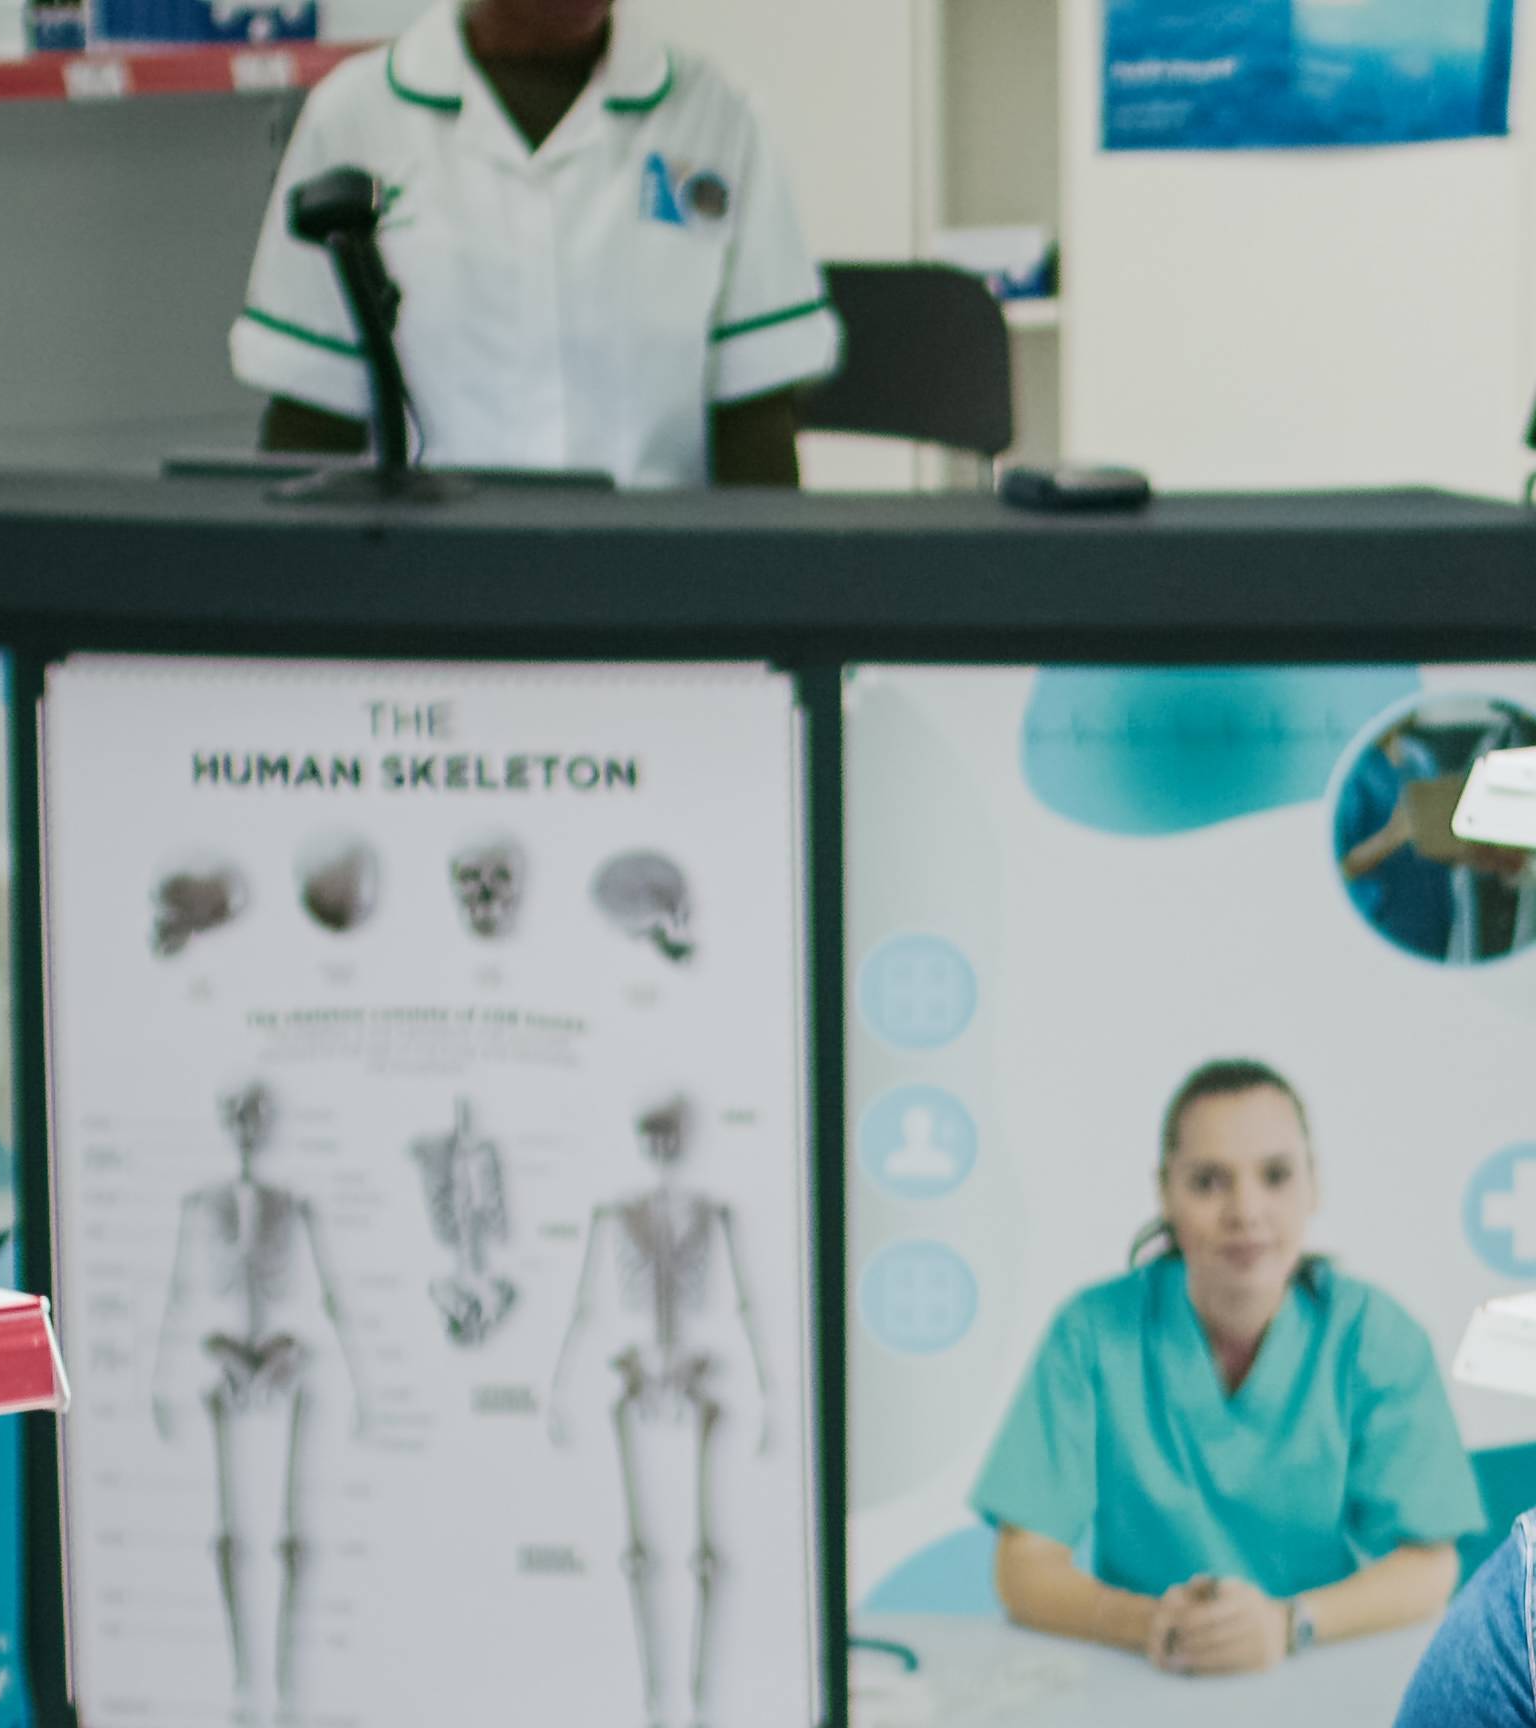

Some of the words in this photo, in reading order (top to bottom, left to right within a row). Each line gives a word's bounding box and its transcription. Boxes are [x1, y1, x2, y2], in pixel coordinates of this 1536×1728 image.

[366, 701, 453, 738] THE
[191, 751, 362, 787] HUMAN
[381, 752, 639, 790] SKELETON
